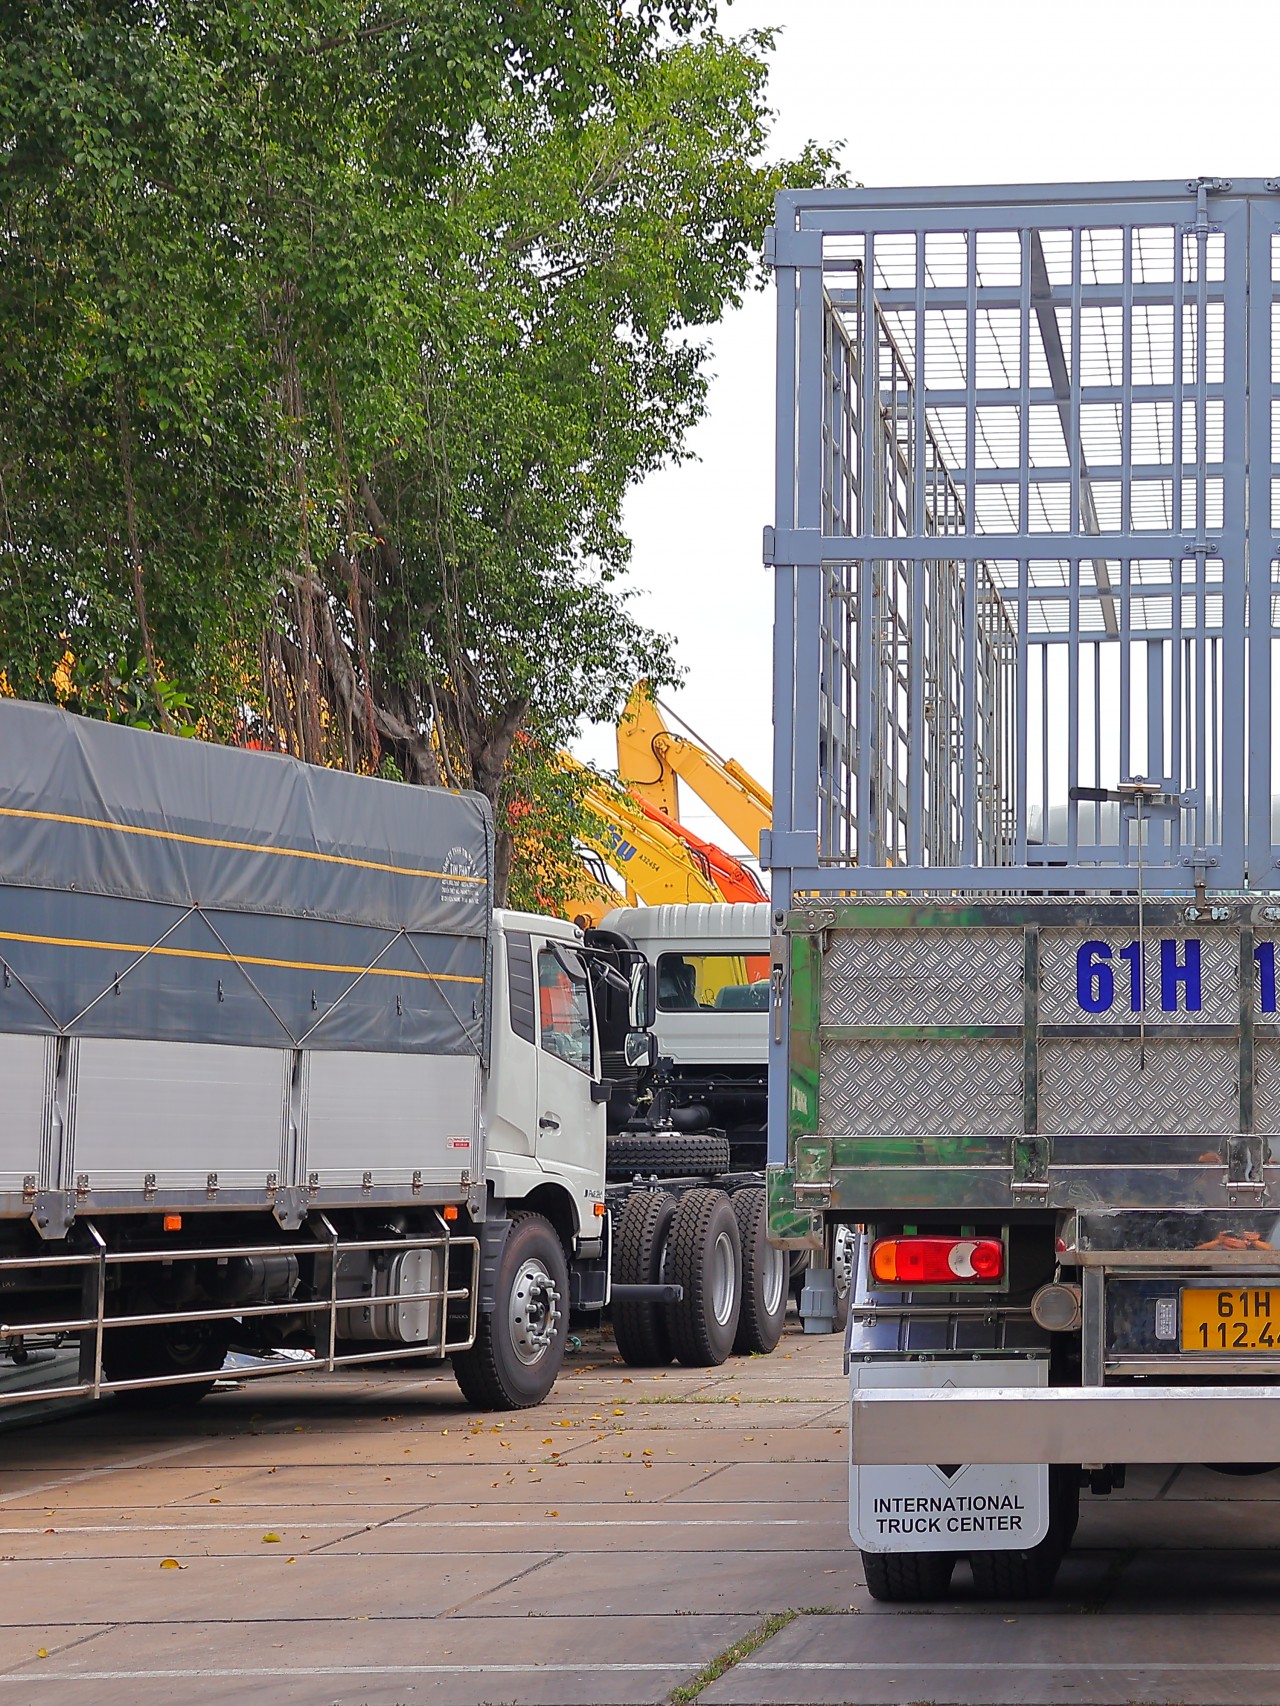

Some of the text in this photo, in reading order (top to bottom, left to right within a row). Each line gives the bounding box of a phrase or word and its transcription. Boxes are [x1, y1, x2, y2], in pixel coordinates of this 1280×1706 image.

[1076, 939, 1201, 1013] 61H
[1217, 1291, 1271, 1318] 61H
[874, 1495, 1025, 1513] INTERNATIONAL
[876, 1515, 1022, 1534] TRUCK CENTER
